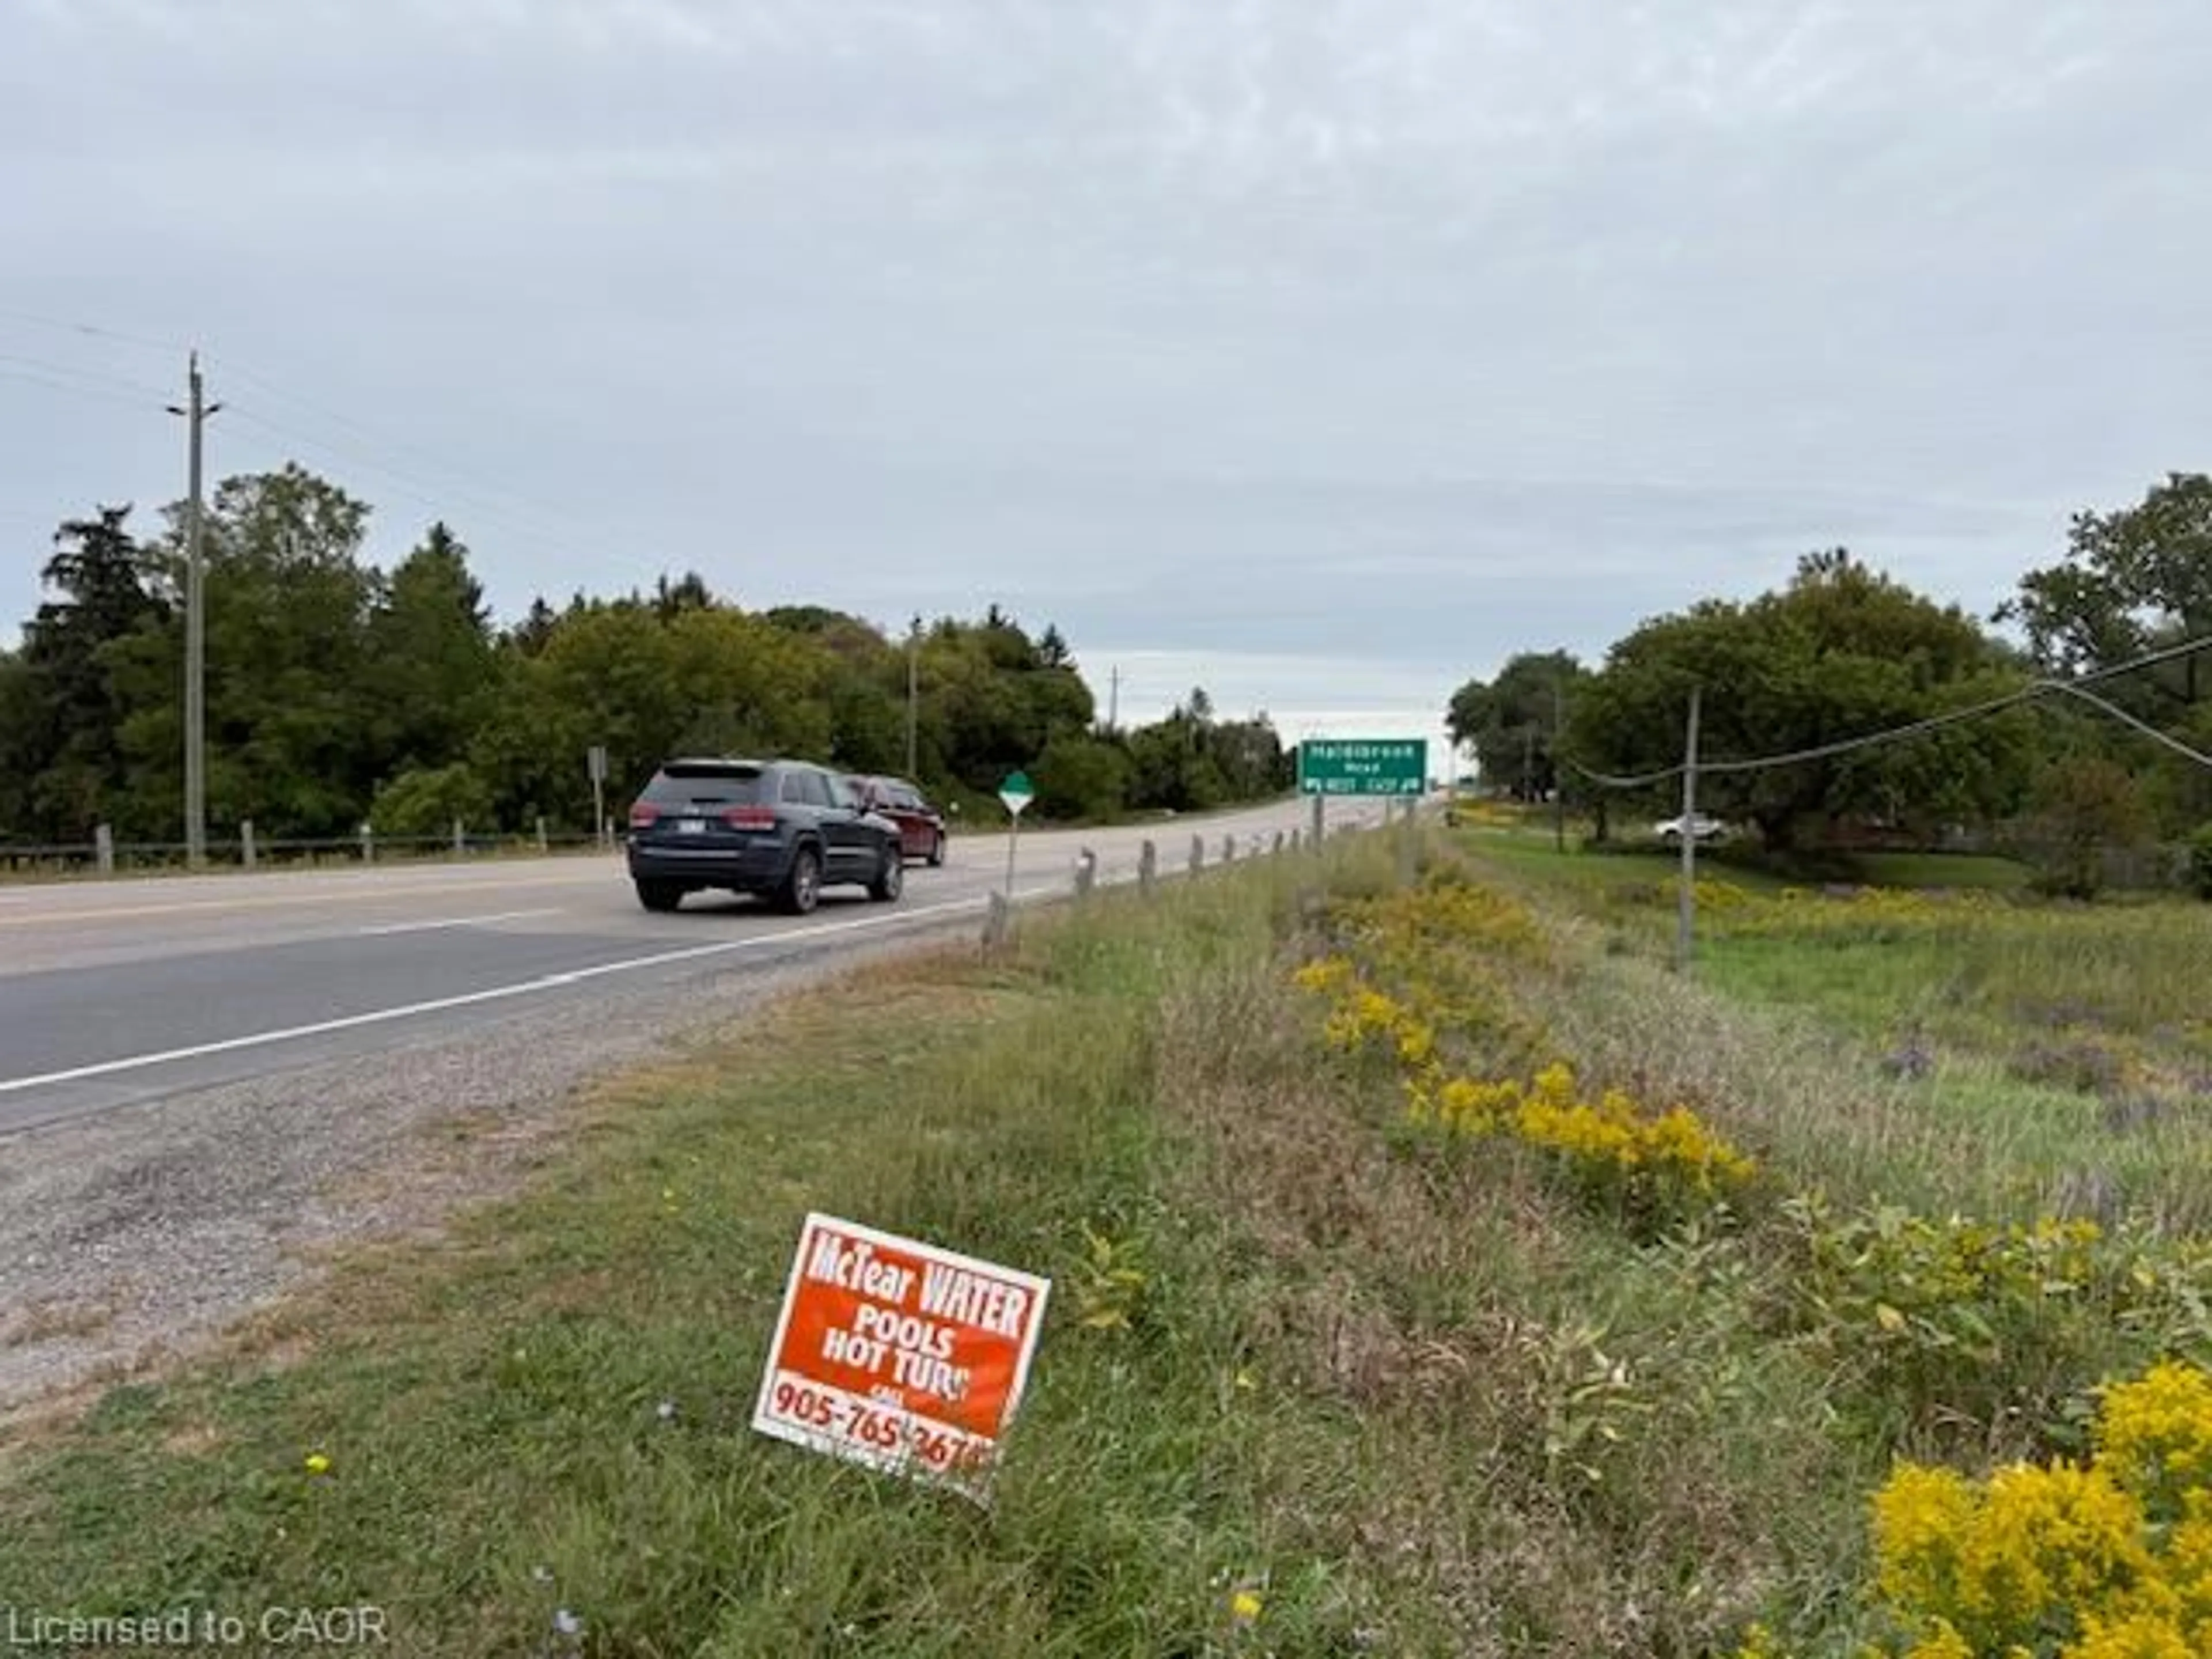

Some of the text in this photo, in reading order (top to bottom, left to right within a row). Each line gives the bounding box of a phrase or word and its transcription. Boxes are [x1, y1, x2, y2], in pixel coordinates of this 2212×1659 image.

[808, 1232, 1028, 1339] McTear WATER
[822, 1327, 889, 1373] HOT
[853, 1304, 957, 1359] POOLS
[775, 1382, 988, 1467] 905-765367
